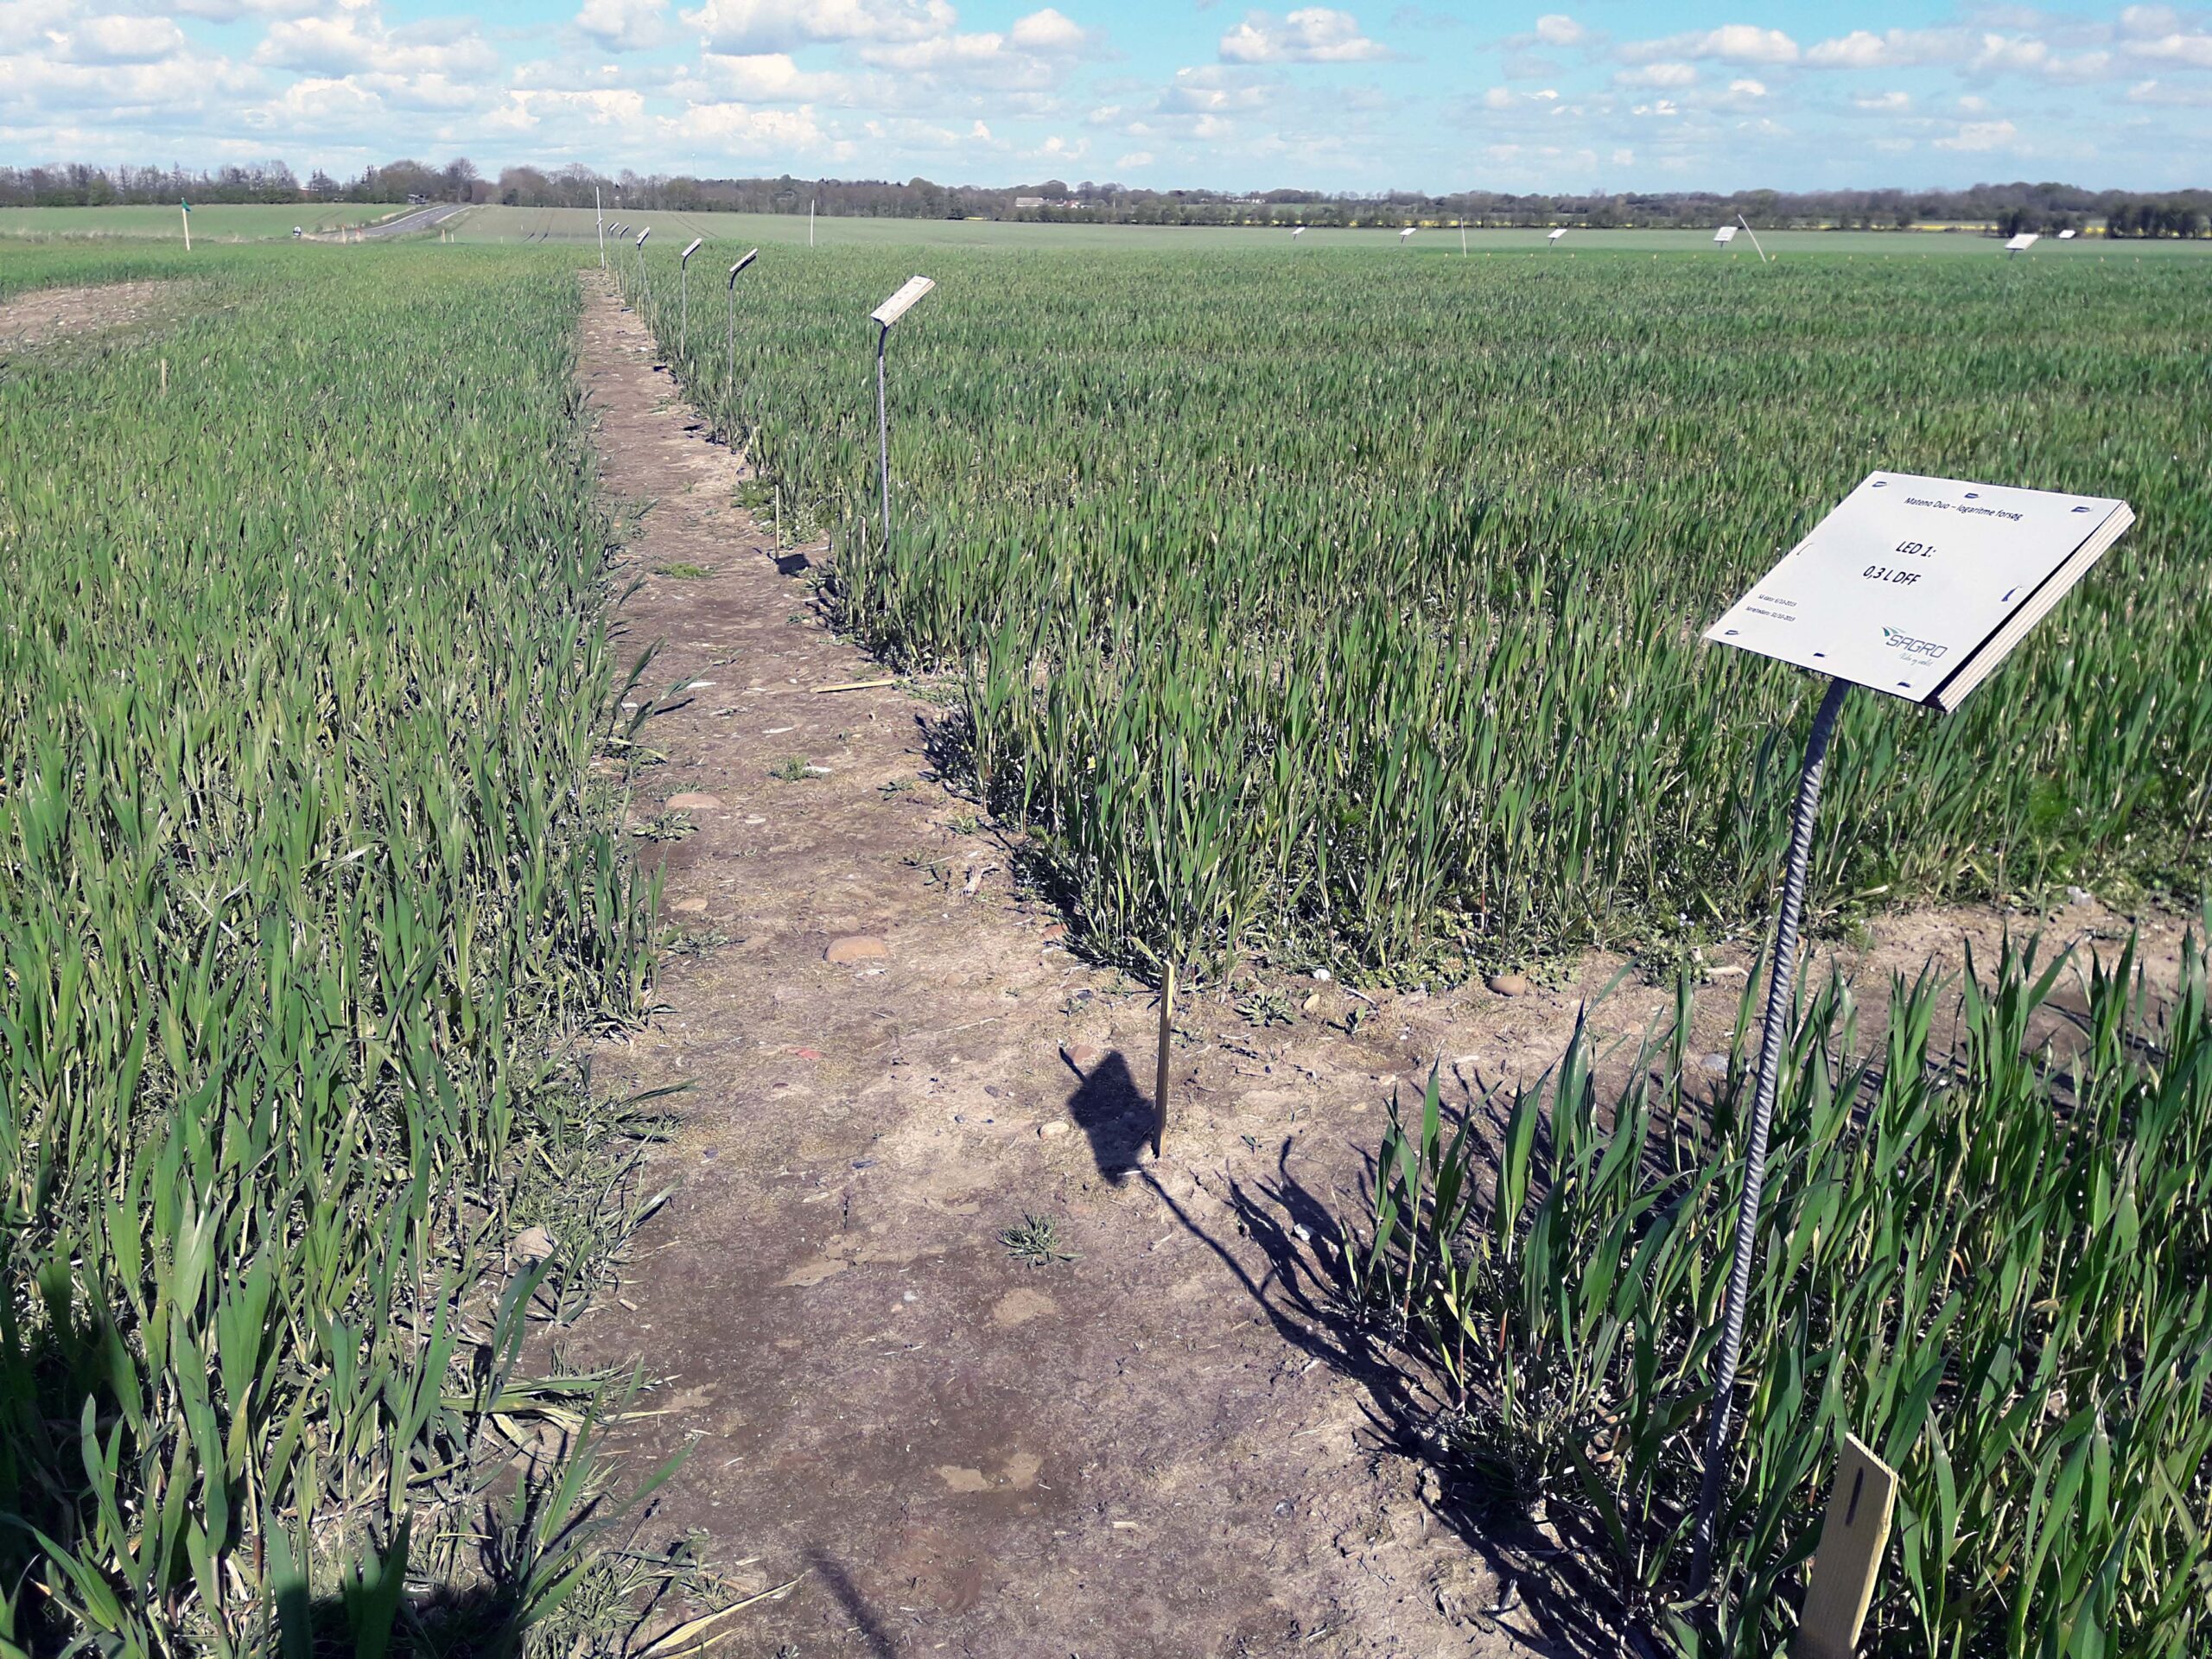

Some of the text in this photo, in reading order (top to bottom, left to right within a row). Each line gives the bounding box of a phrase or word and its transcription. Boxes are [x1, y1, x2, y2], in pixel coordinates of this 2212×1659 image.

[1904, 497, 1934, 507] Mateno
[1933, 500, 1950, 510] Duo
[1956, 504, 1995, 517] logaritme
[1995, 509, 2024, 522] forsøg
[1895, 541, 1936, 558] LED 1:
[1863, 565, 1922, 586] 0,3 L DFF
[1885, 634, 1948, 658] SAGRO
